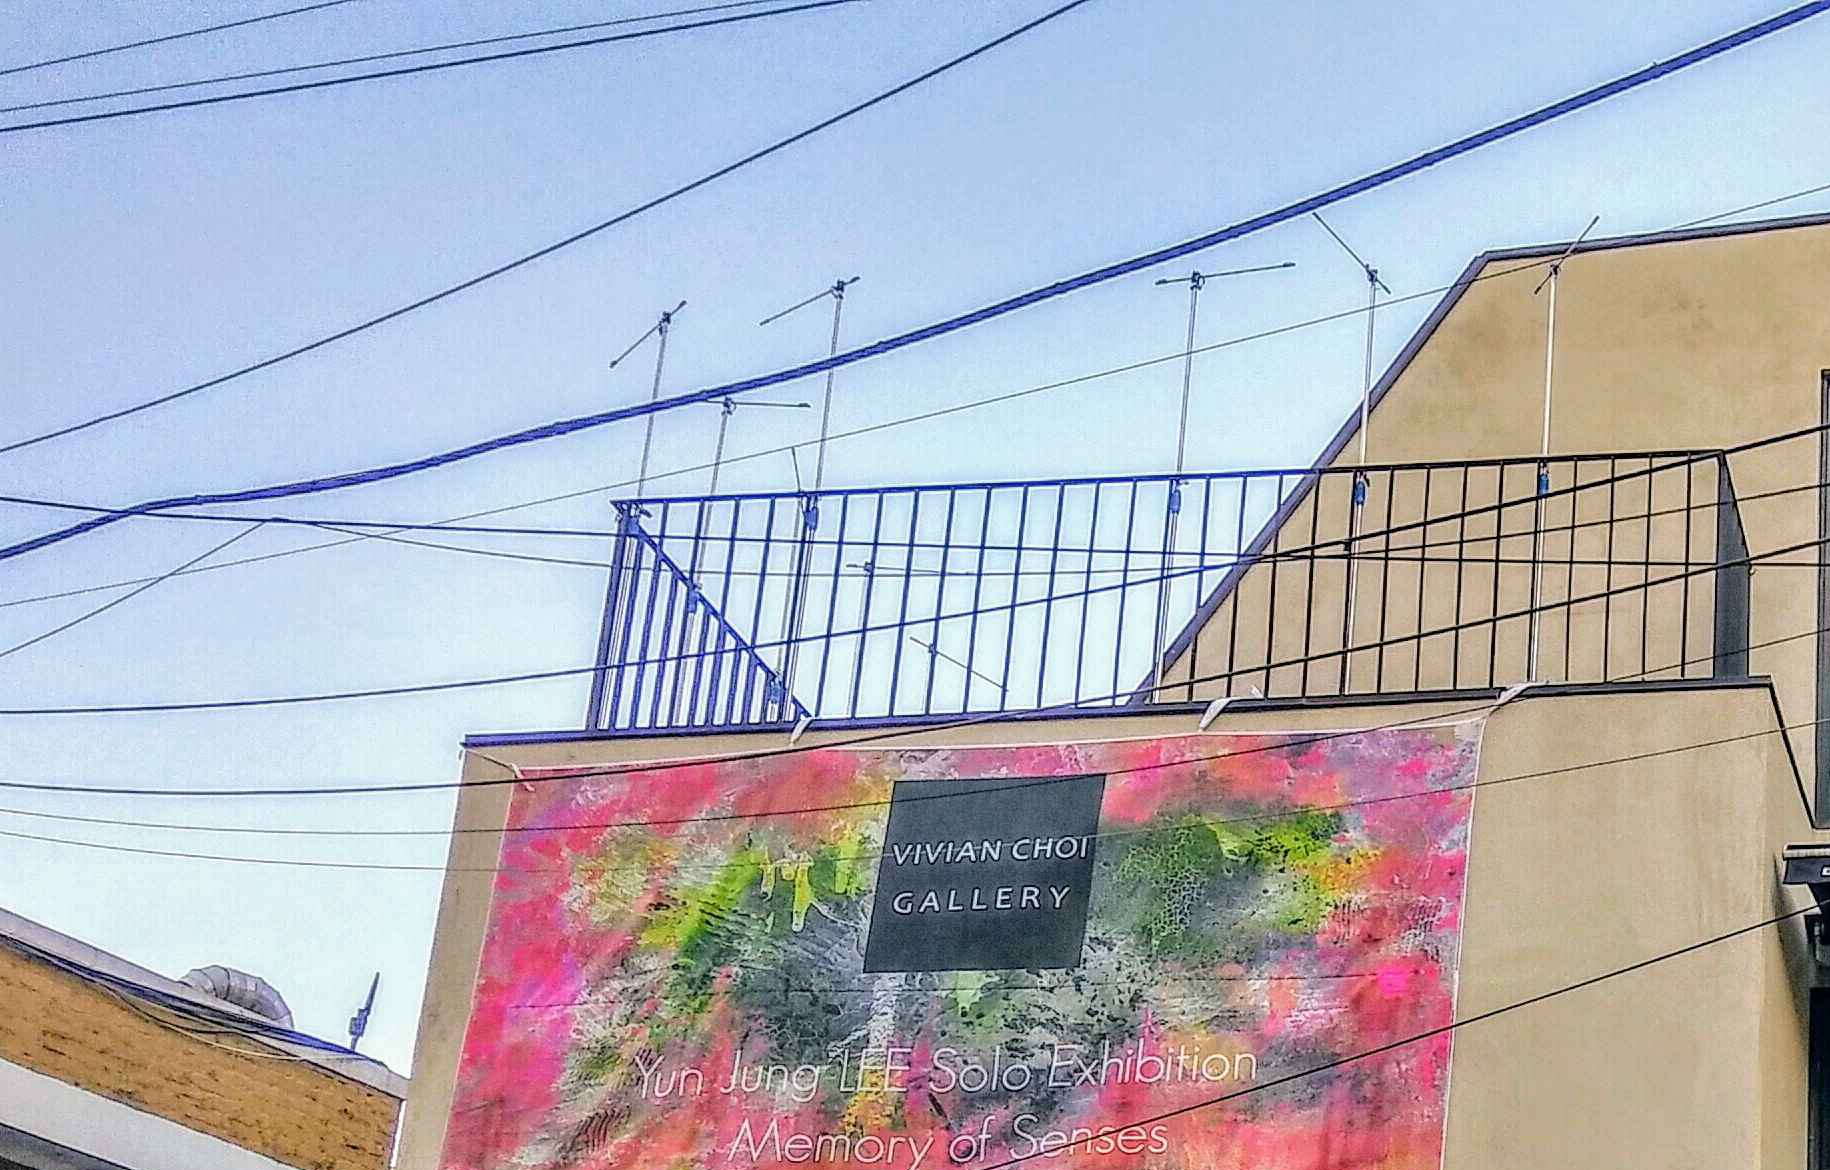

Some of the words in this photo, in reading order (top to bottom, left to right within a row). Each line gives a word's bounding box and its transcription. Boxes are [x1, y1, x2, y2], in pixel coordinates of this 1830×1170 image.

[892, 839, 1002, 866] VIVIAN
[1011, 835, 1090, 861] CHOI
[892, 885, 1071, 915] GALLERY
[635, 1053, 704, 1100] Yun
[719, 1049, 822, 1103] Jung
[838, 1047, 912, 1093] LEE
[929, 1046, 1032, 1093] Solo
[1047, 1037, 1257, 1089] Exhibition
[948, 1114, 996, 1164] of
[1007, 1112, 1169, 1160] Senses
